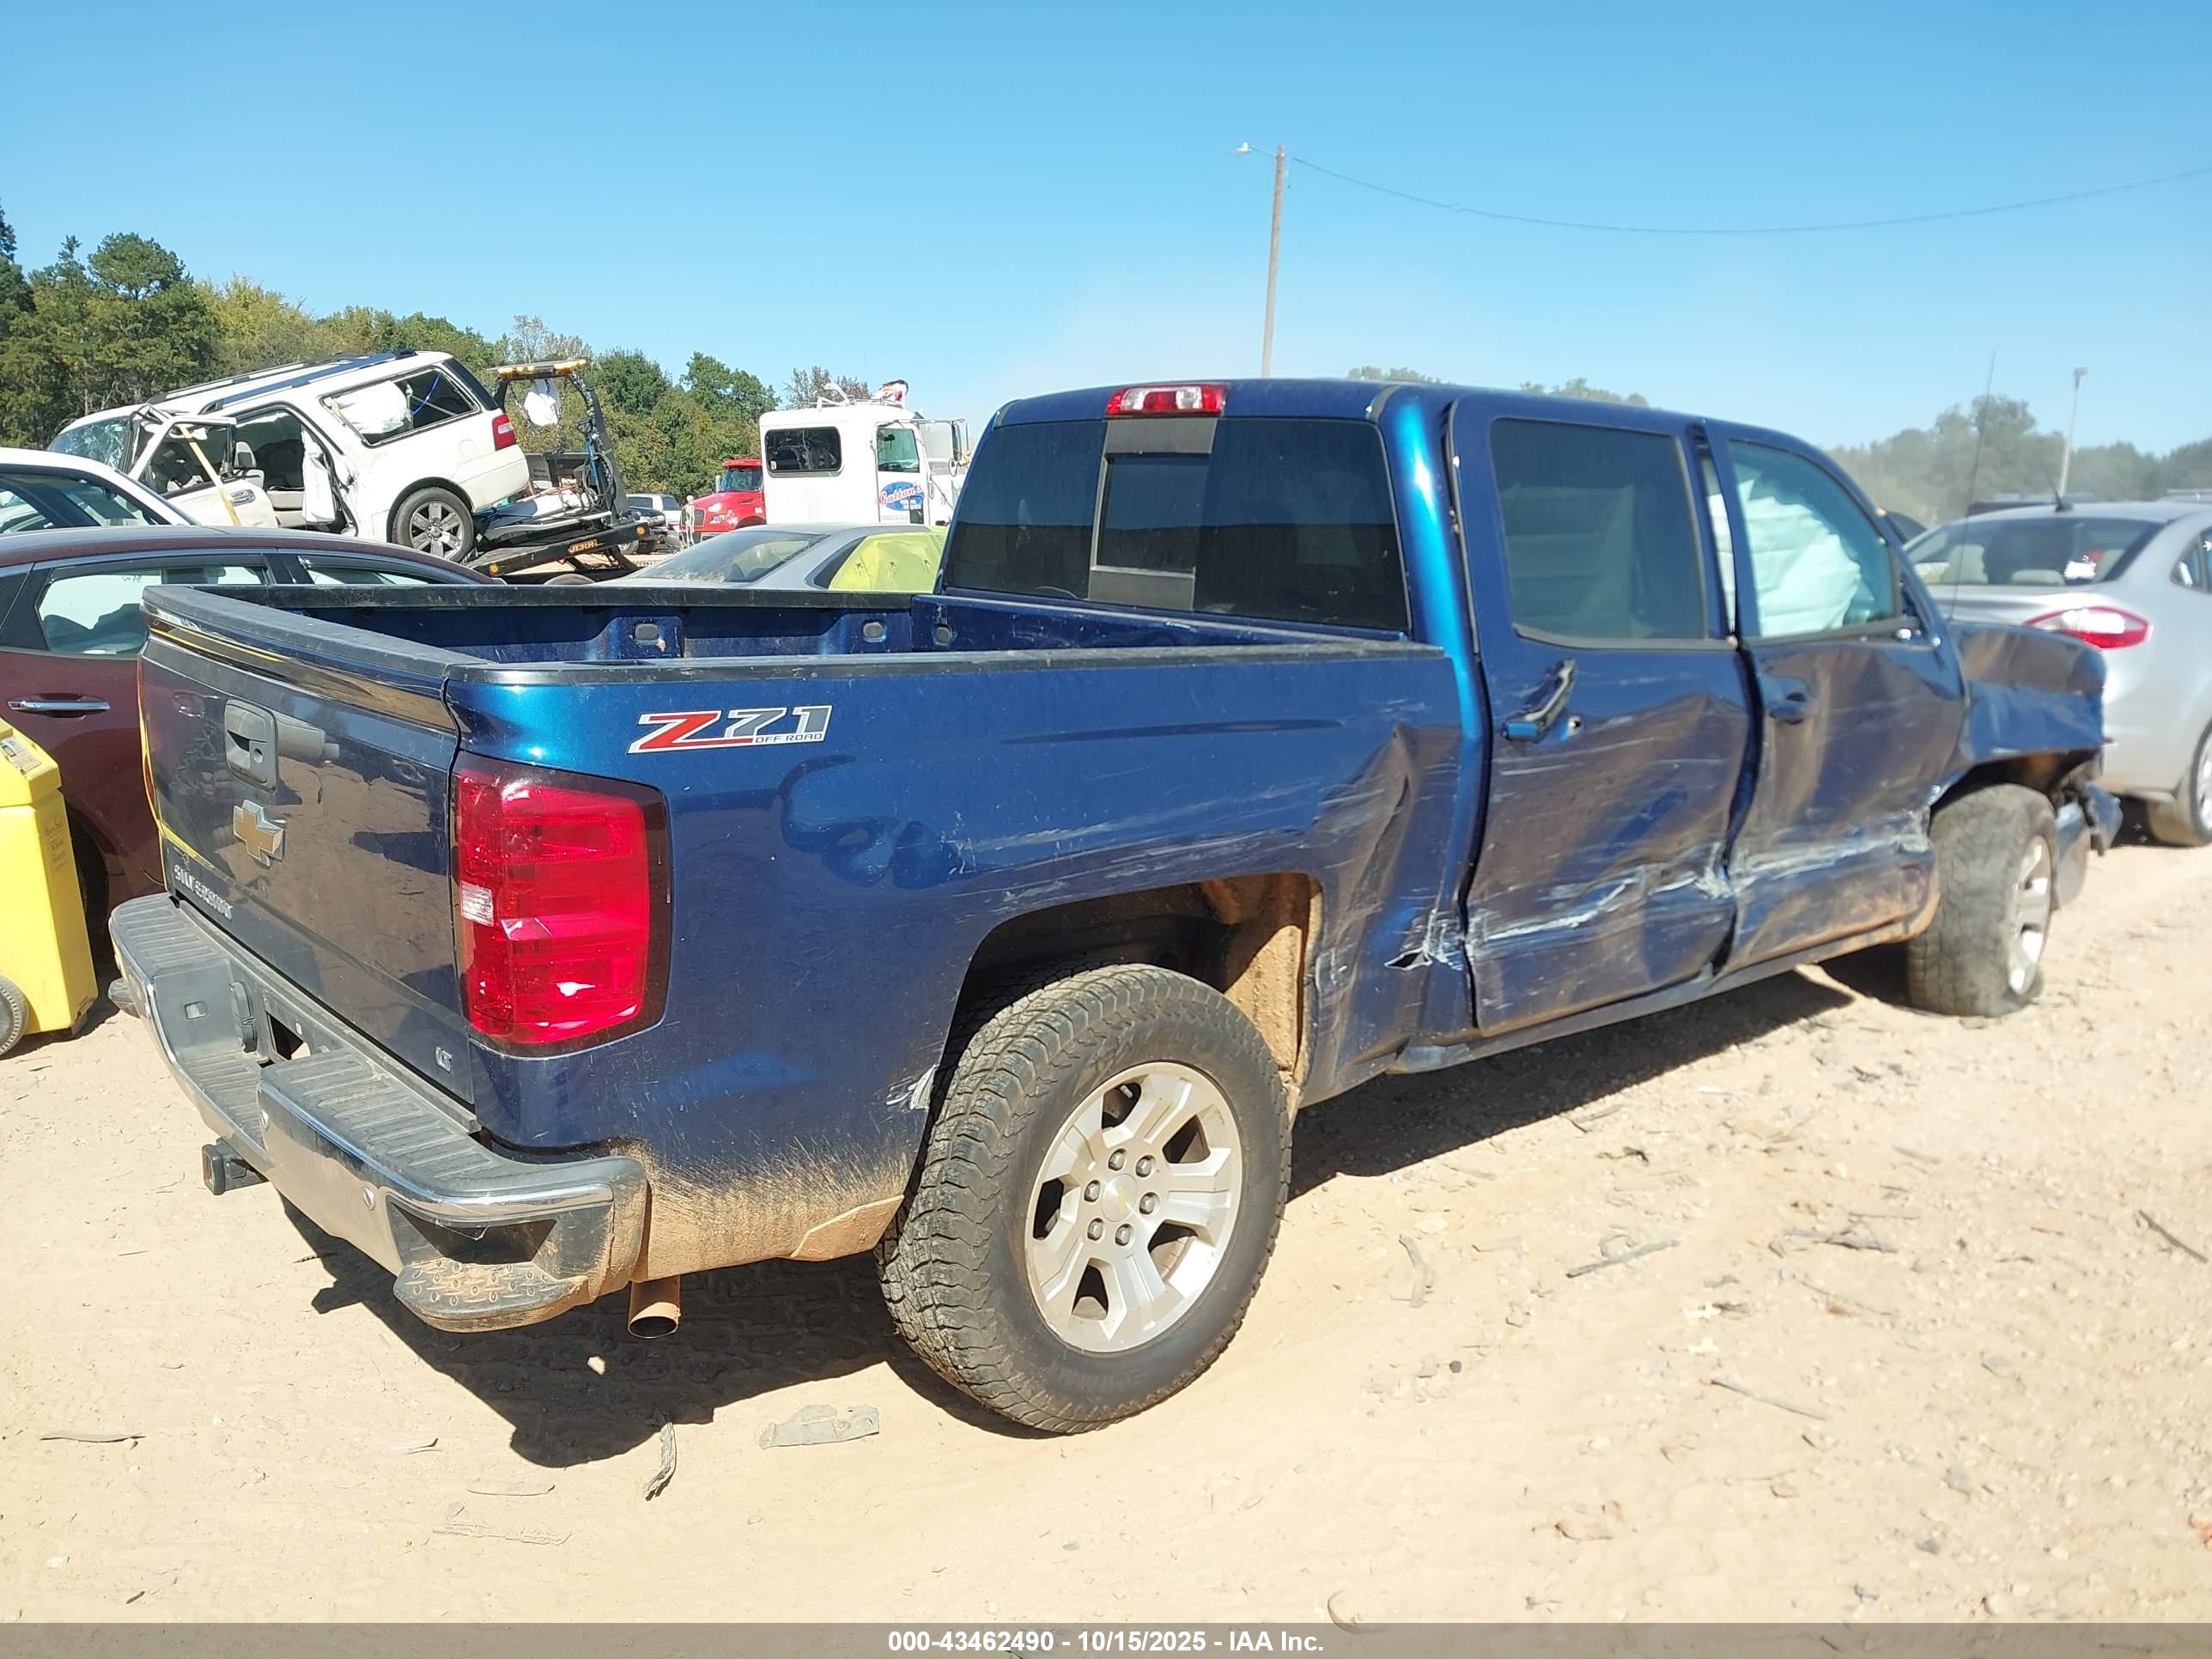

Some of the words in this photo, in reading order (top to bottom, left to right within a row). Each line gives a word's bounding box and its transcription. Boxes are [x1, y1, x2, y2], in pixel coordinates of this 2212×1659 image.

[627, 705, 832, 754] Z71
[756, 735, 782, 744] OFF
[786, 732, 823, 741] ROAD
[435, 1047, 452, 1073] LT
